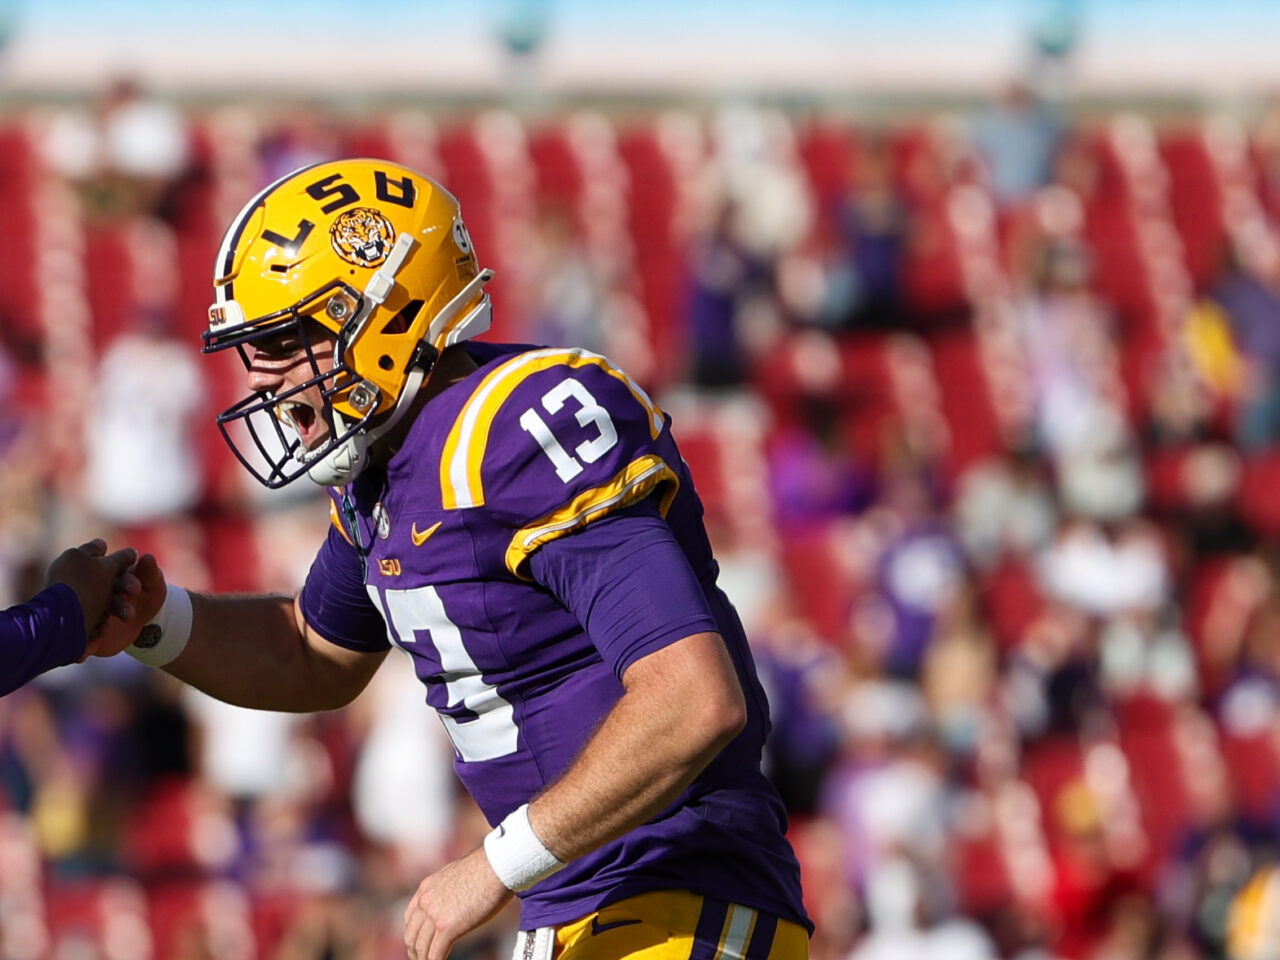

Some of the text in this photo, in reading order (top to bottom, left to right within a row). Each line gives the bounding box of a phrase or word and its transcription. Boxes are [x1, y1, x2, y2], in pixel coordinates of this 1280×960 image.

[261, 170, 416, 253] LSU
[520, 377, 619, 484] 13
[376, 558, 403, 577] LSU
